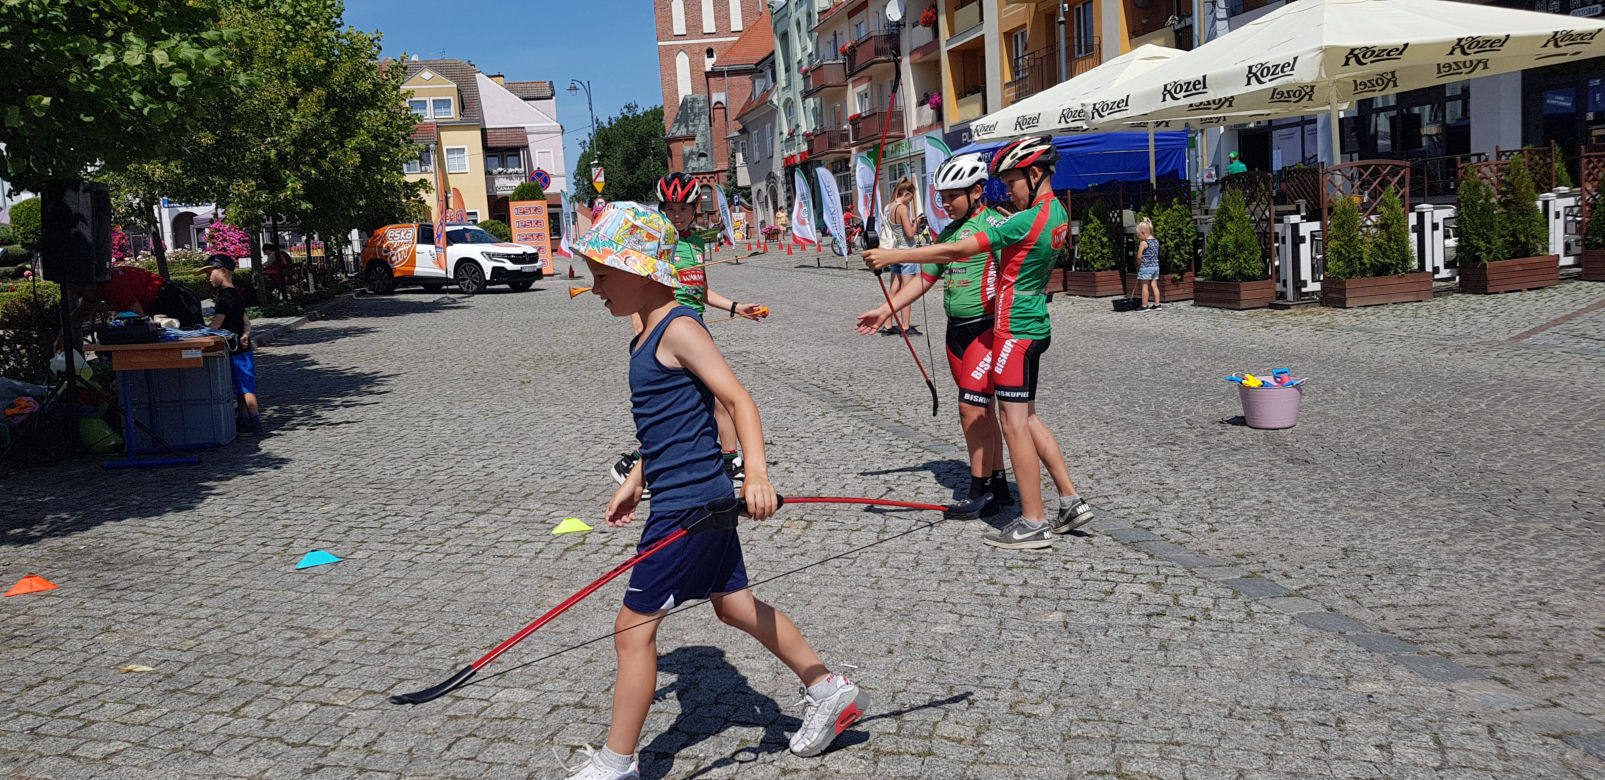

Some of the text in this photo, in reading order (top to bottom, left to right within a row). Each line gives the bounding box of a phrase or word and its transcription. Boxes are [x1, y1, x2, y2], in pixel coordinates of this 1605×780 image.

[1446, 34, 1510, 56] Kozel
[1540, 28, 1603, 48] Kozel
[1341, 42, 1409, 67] Kozel
[1245, 56, 1299, 86] Kozel
[1161, 74, 1208, 103] Kozel
[1058, 105, 1086, 124] Koze
[1091, 94, 1131, 120] Kozel
[973, 121, 998, 137] Kozel
[1014, 113, 1041, 131] Kozel
[734, 195, 739, 205] P
